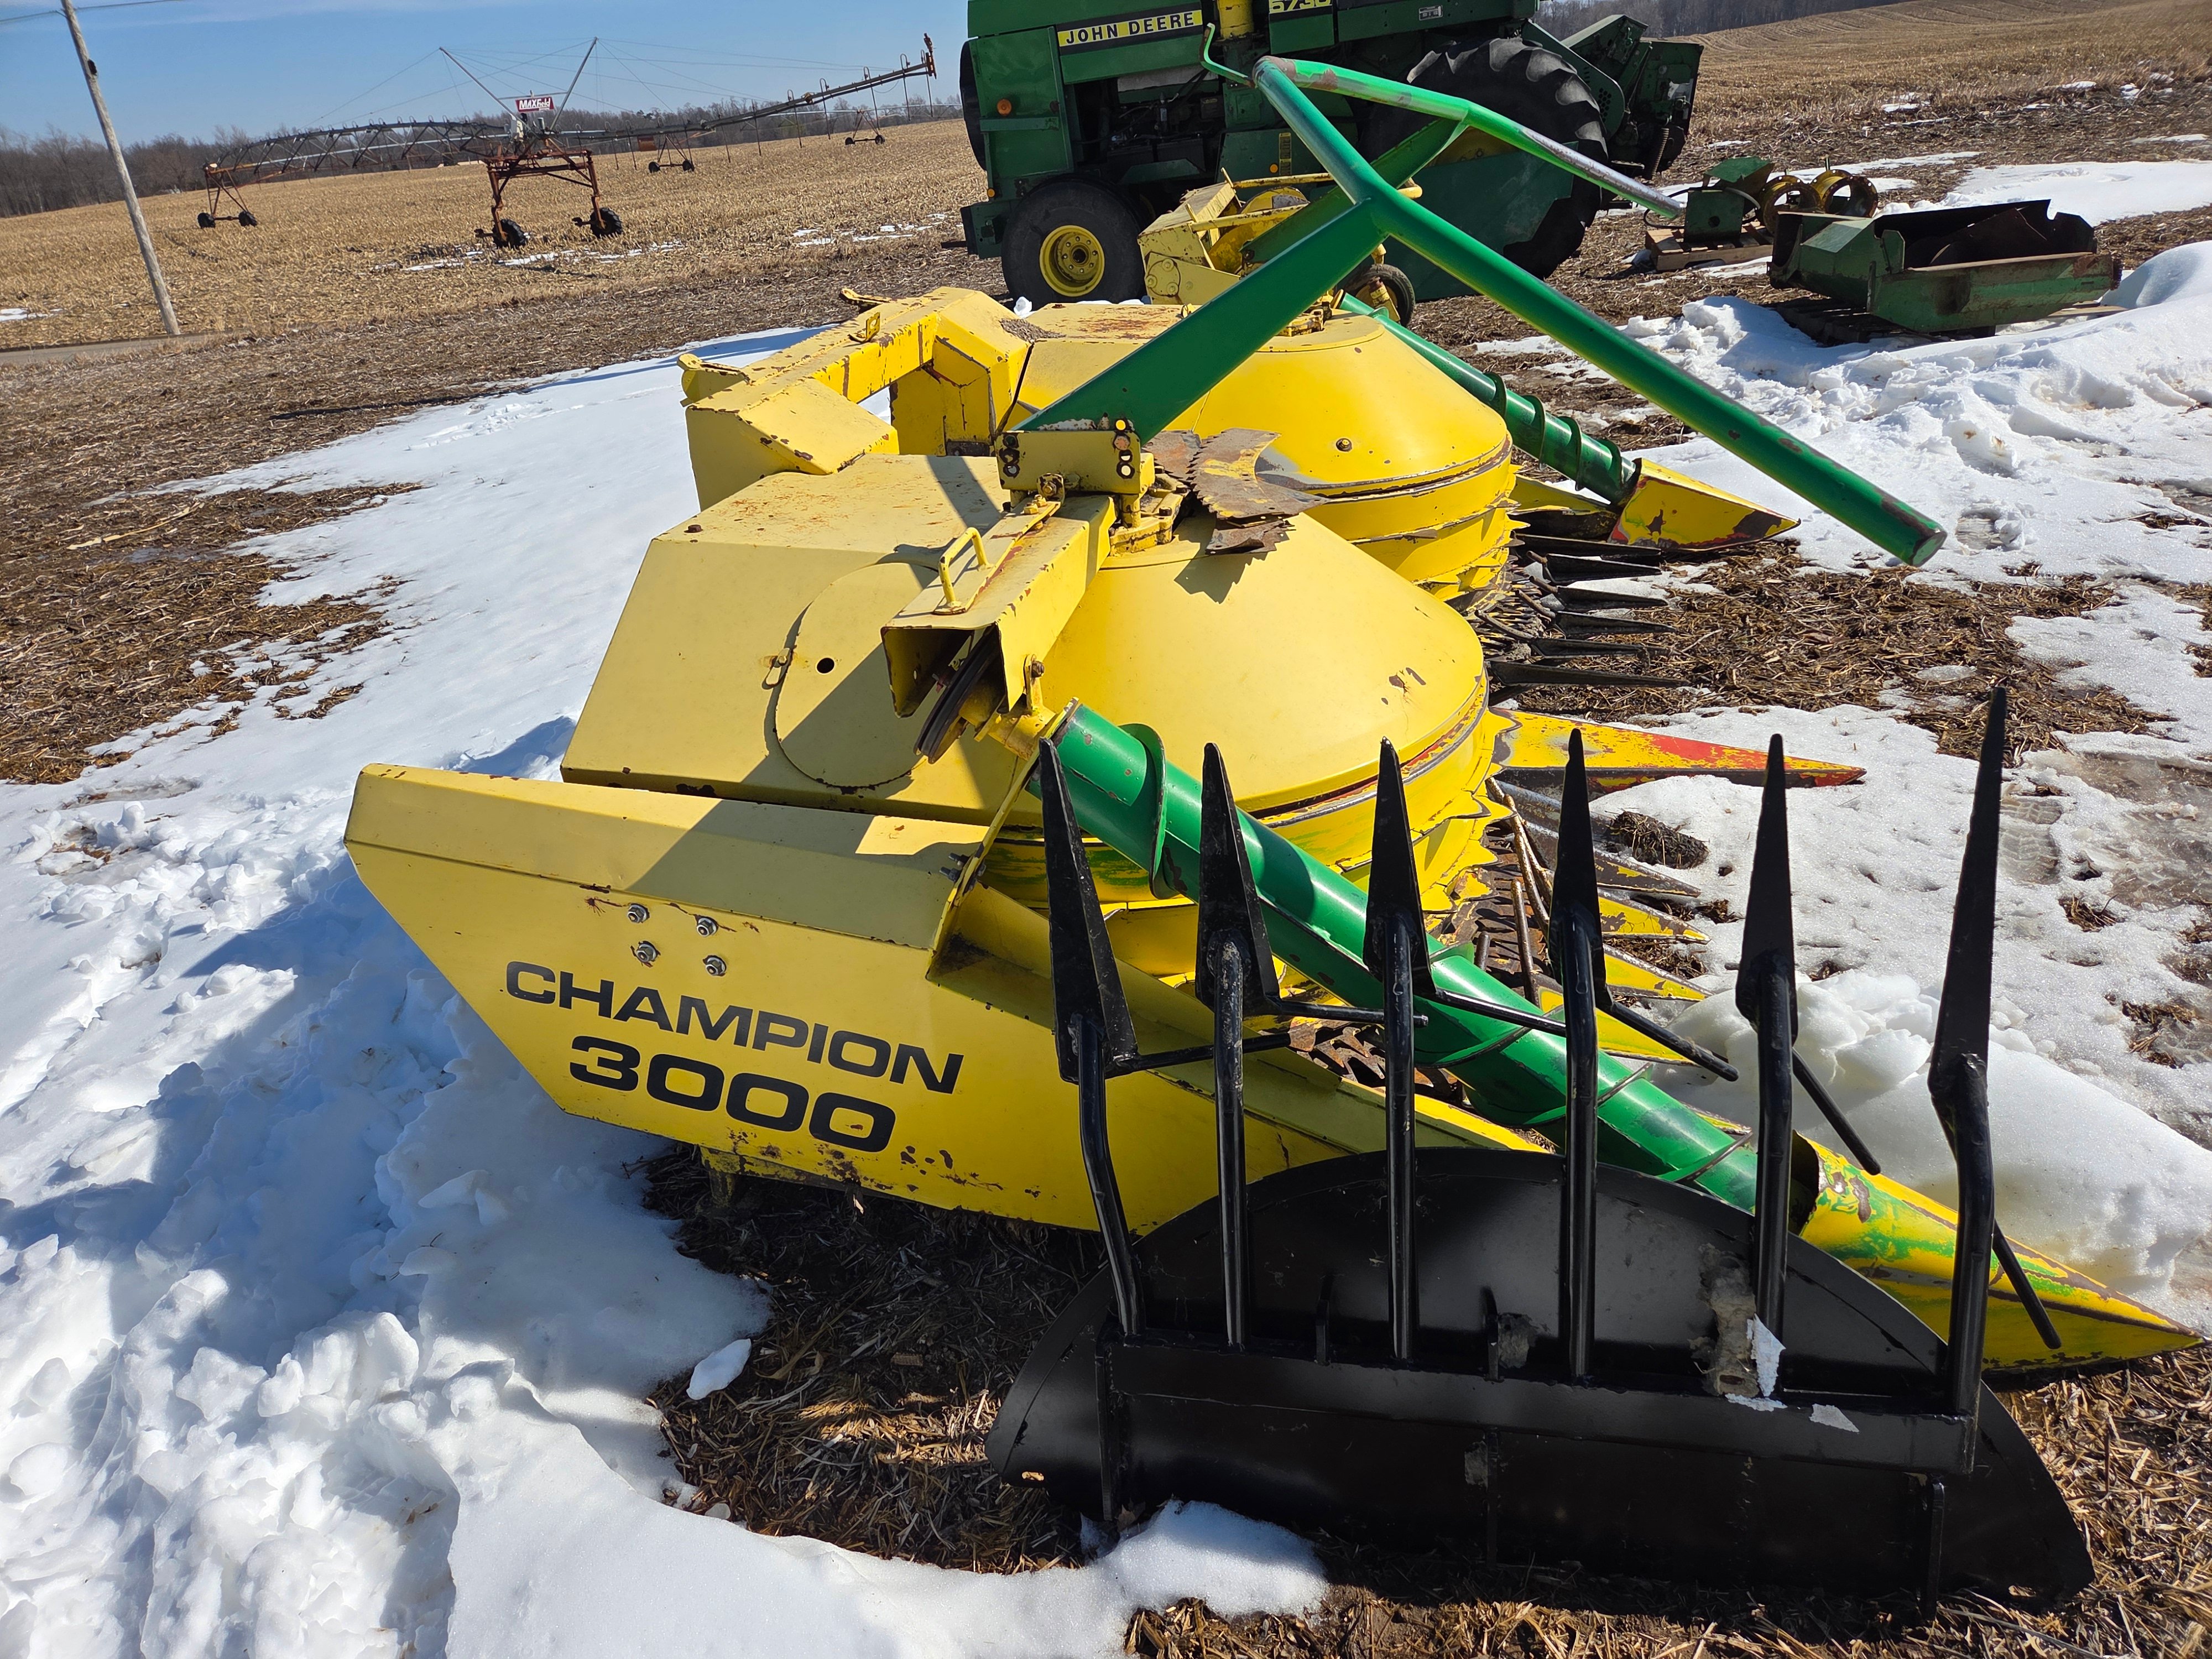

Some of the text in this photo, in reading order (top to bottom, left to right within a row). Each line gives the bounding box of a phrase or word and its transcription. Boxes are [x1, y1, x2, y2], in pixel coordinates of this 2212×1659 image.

[1066, 12, 1194, 44] JOHN DEERE
[506, 961, 964, 1094] CHAMPION
[570, 1036, 896, 1152] 3000
